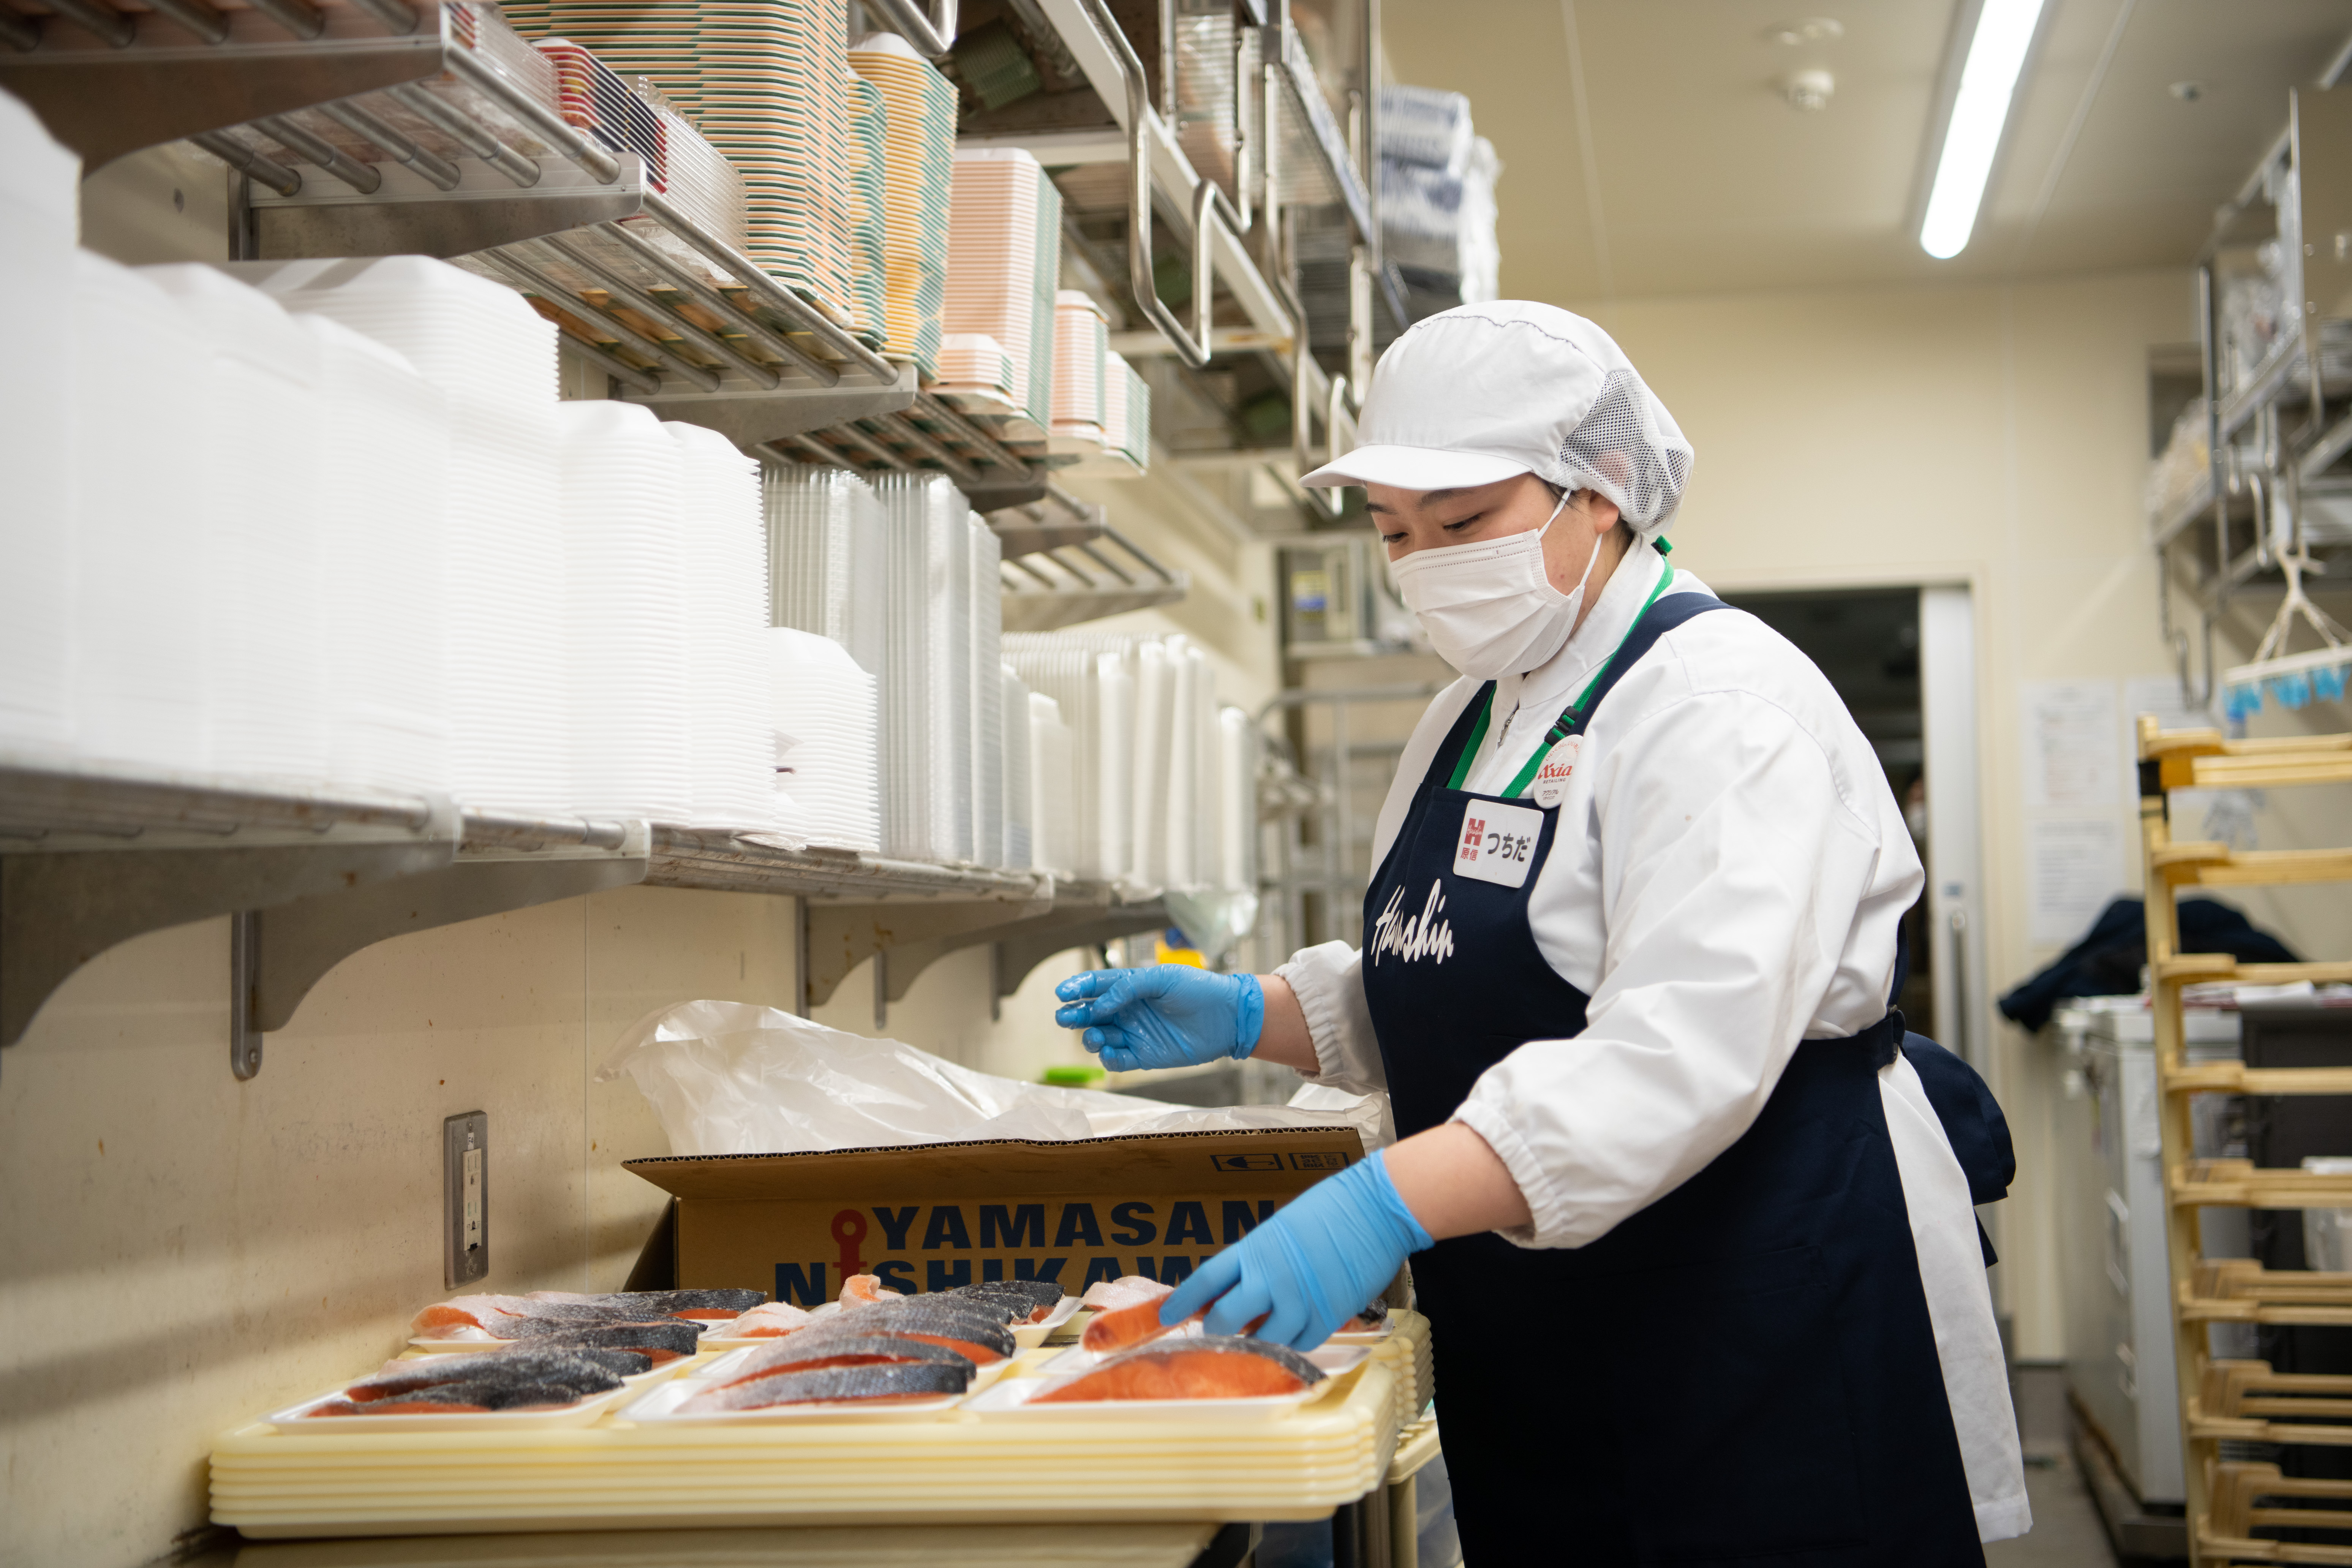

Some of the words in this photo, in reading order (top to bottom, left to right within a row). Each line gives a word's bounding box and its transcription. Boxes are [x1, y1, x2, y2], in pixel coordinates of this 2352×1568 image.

[1538, 763, 1573, 780] Axia
[1461, 847, 1478, 861] 原信
[1487, 833, 1530, 862] つちだ
[871, 1200, 1274, 1250] YAMASAN
[775, 1255, 1216, 1306] NISHIKAW
